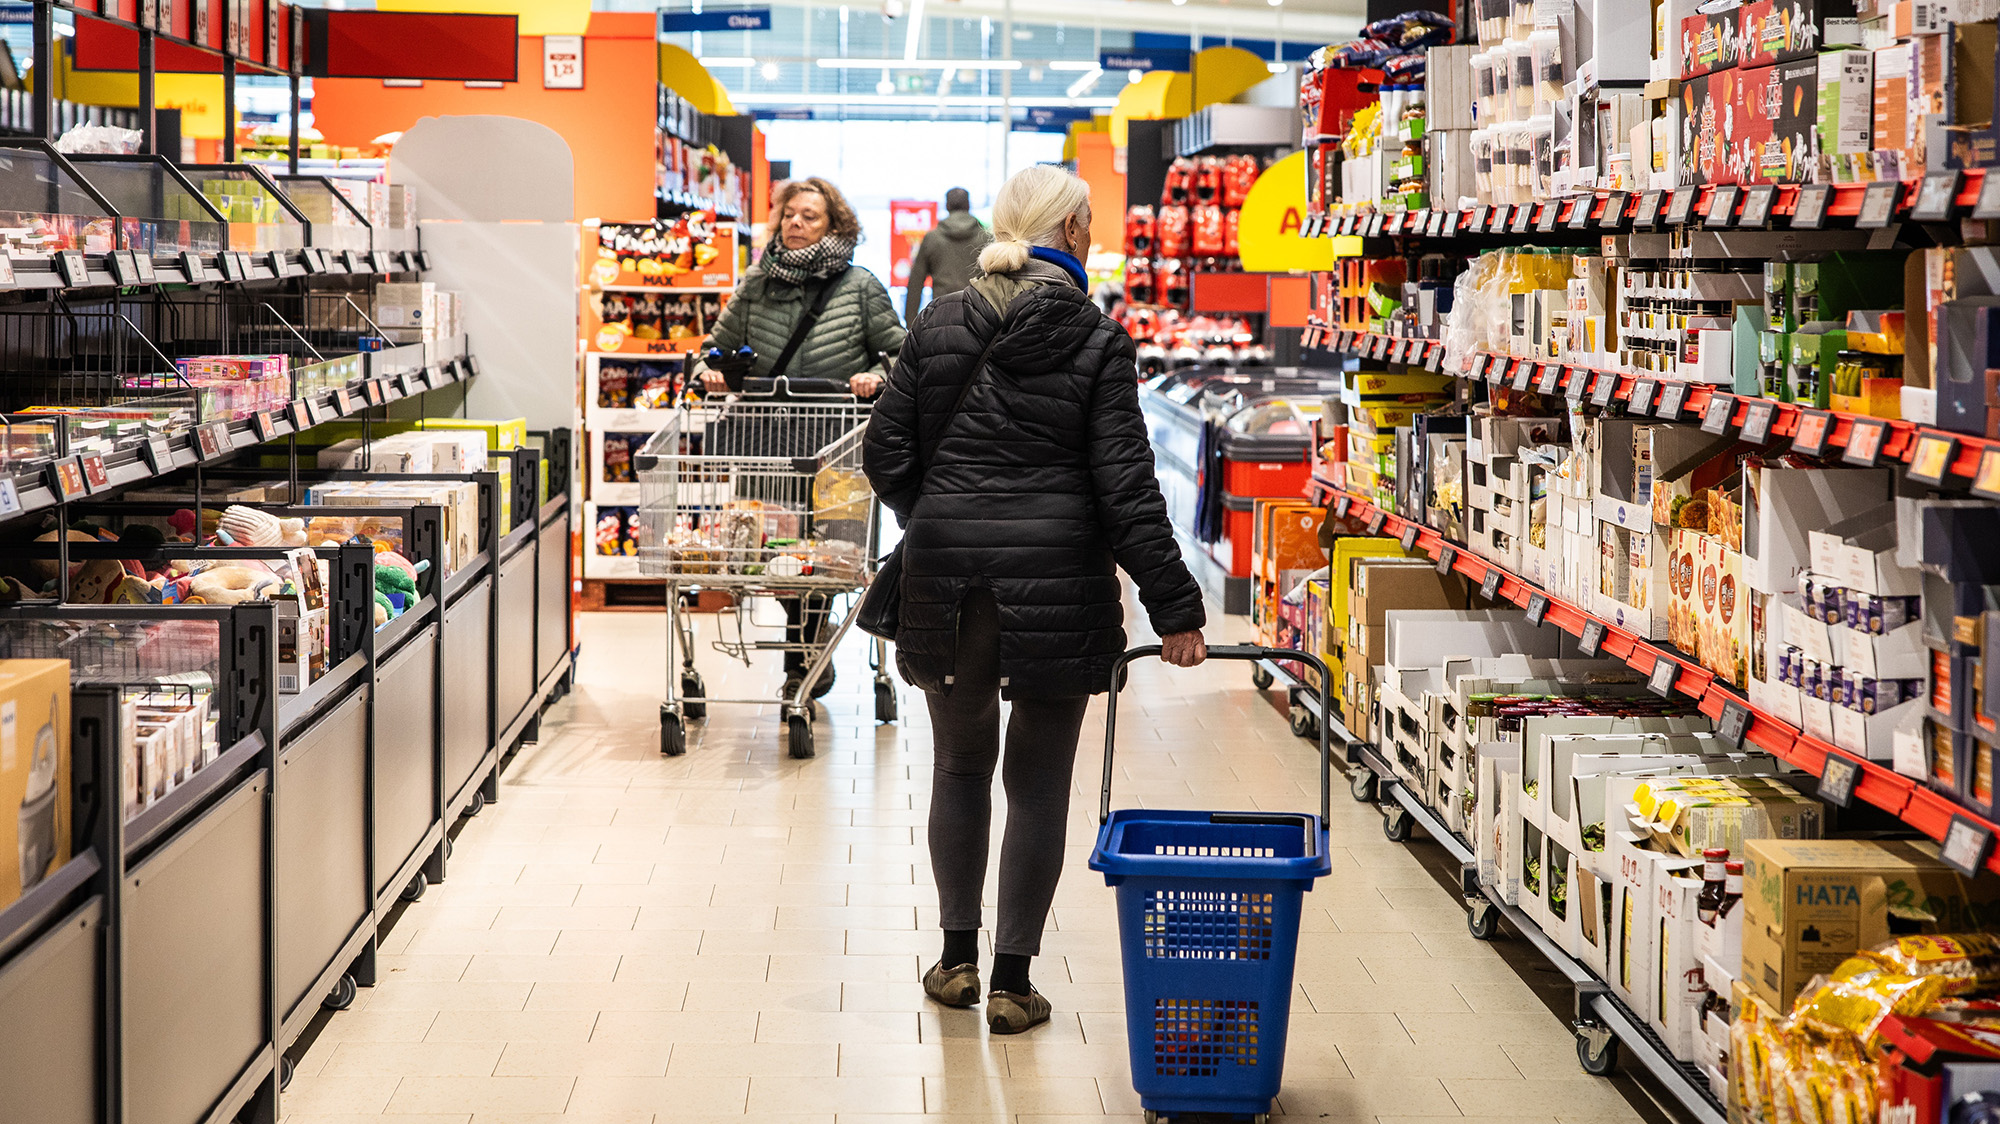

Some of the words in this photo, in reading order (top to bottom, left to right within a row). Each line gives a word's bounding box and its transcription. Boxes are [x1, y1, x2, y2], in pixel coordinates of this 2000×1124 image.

[727, 15, 761, 28] Chips
[643, 275, 673, 286] MAX
[647, 342, 677, 353] MAX
[1796, 885, 1860, 906] HATA
